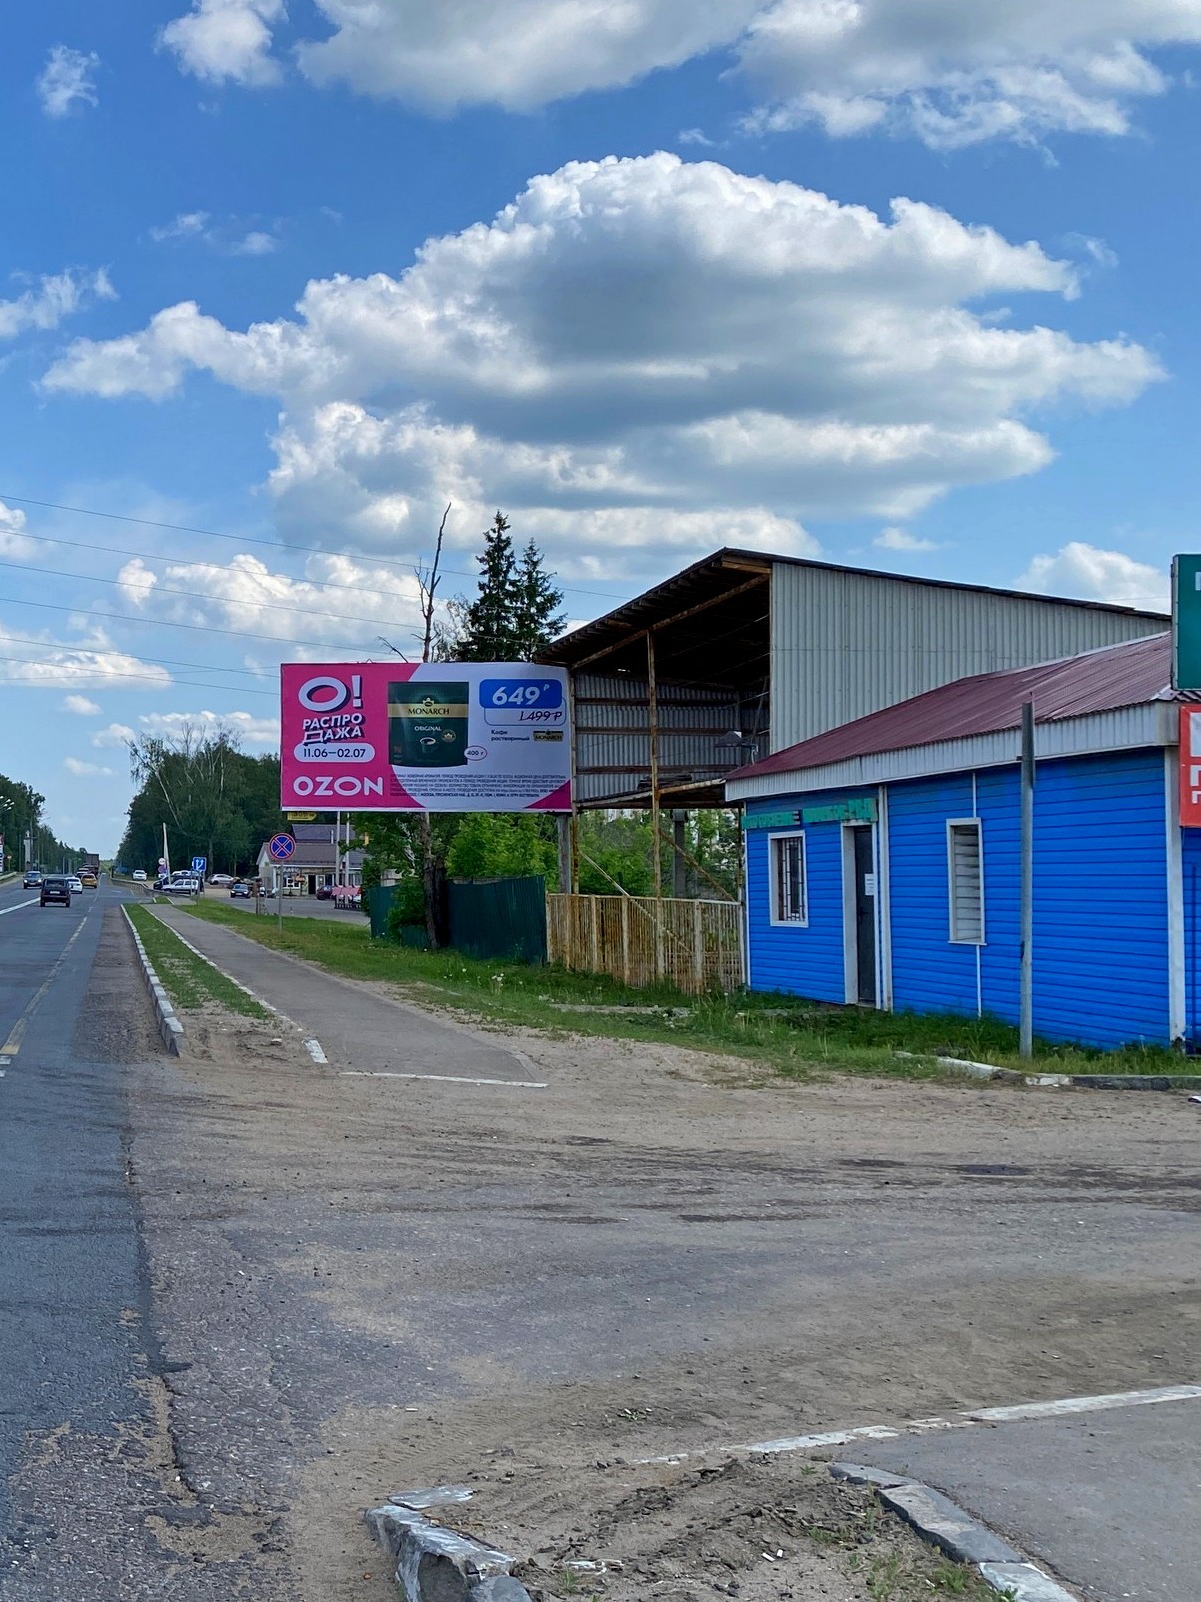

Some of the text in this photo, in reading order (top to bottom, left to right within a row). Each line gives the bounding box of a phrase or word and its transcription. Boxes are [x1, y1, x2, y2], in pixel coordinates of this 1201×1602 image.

[492, 687, 540, 706] 649
[407, 707, 450, 715] MONARCH
[302, 712, 363, 730] РАСПРО
[302, 725, 362, 744] ДАЖА
[293, 776, 383, 796] OZON
